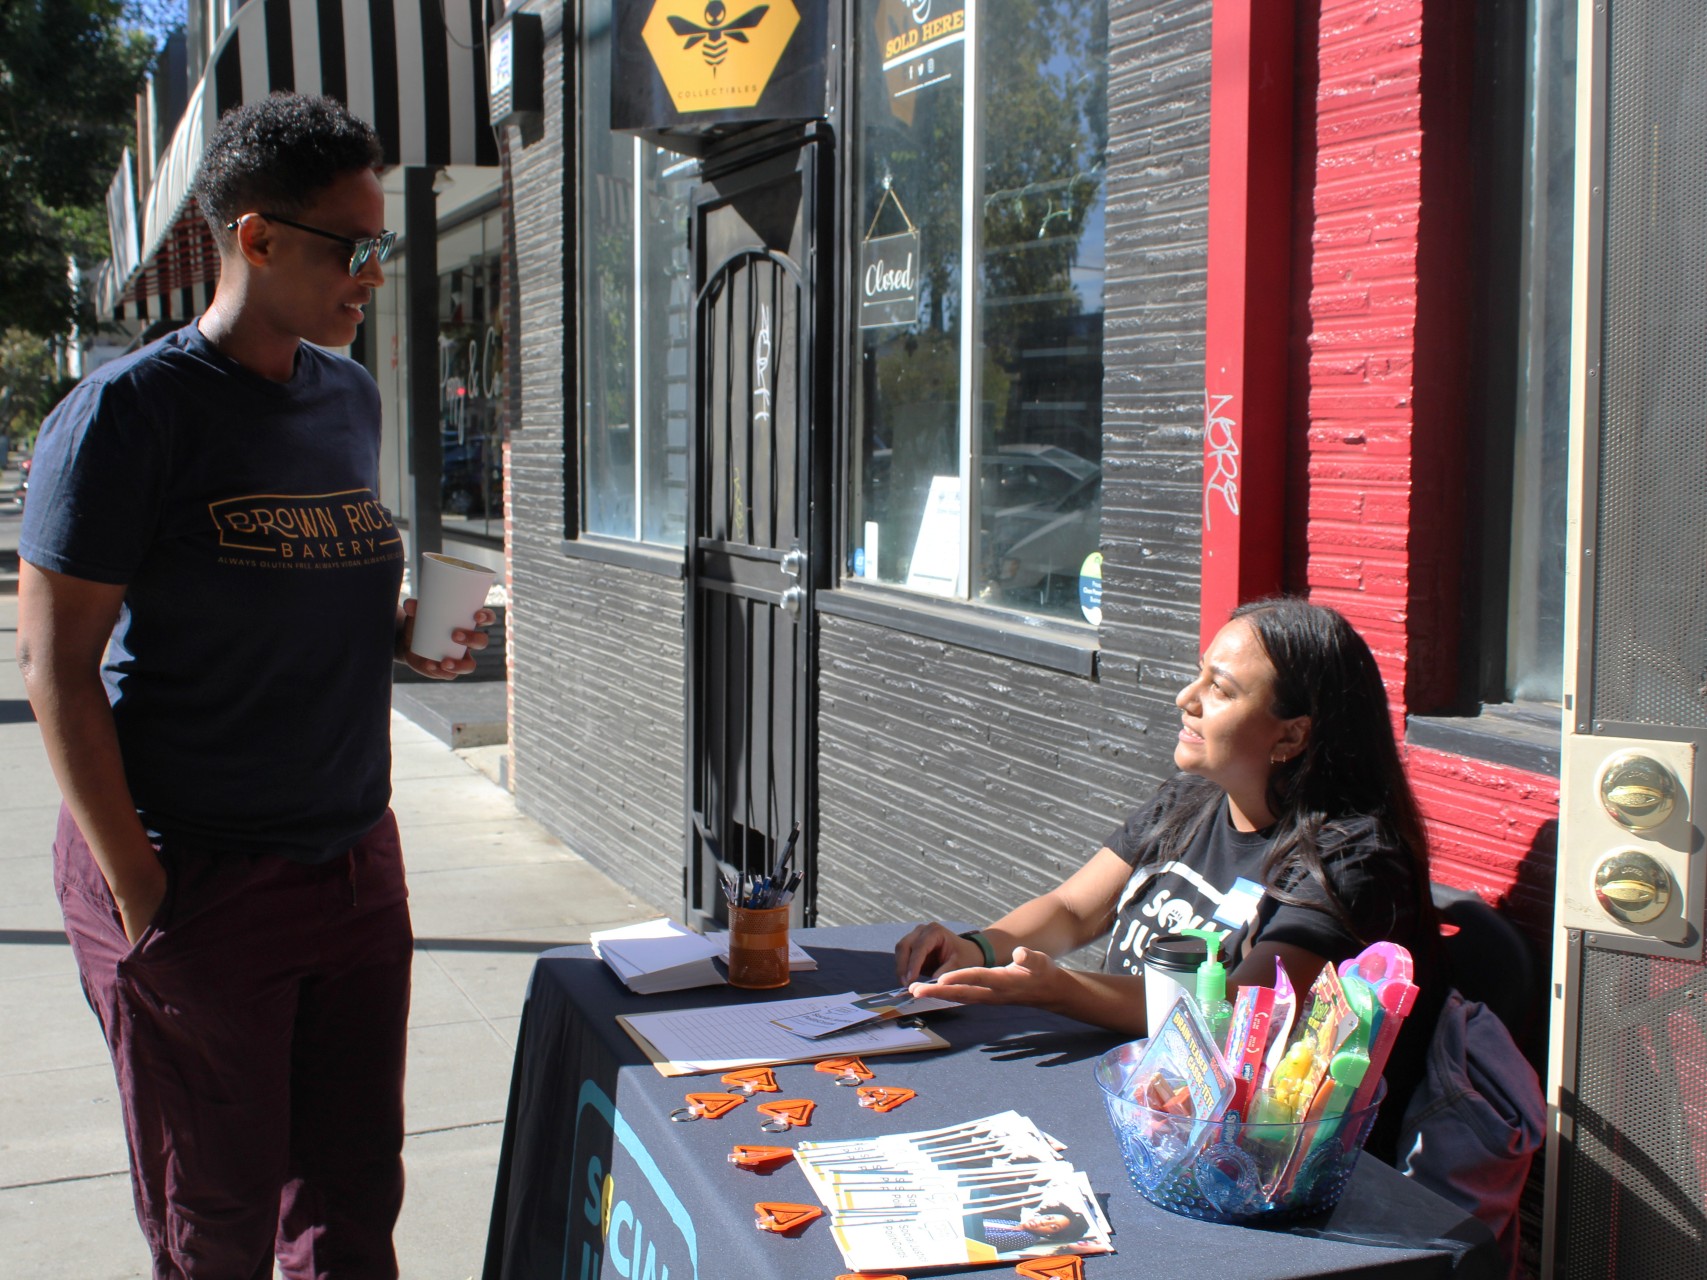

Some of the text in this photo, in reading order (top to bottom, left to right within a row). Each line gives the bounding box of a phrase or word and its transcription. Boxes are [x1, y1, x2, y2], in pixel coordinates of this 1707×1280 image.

[886, 28, 918, 58] SOLD
[922, 9, 964, 41] HERE
[678, 84, 757, 99] COLLECTIBLES
[865, 252, 914, 296] Closed
[225, 500, 393, 538] BROWN RICE
[218, 556, 257, 567] ALWAYS
[281, 538, 375, 558] BAKERY
